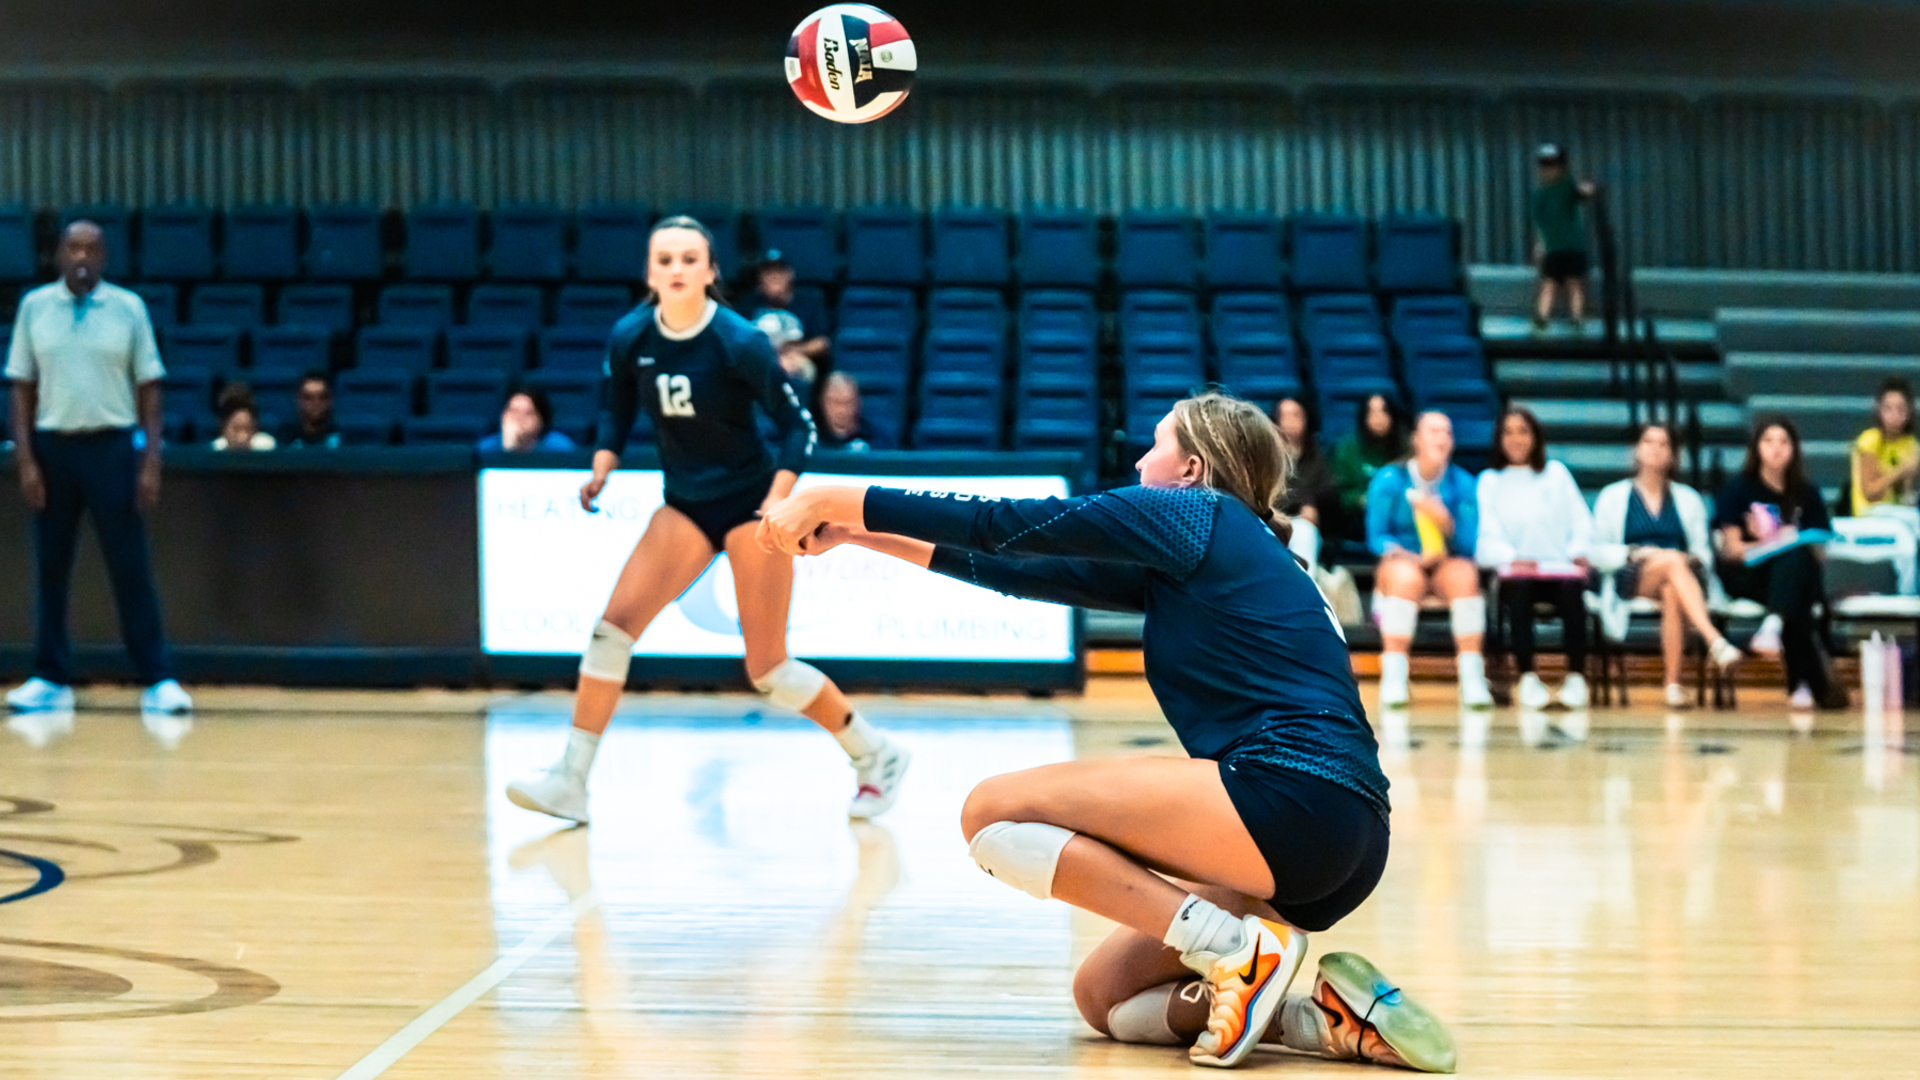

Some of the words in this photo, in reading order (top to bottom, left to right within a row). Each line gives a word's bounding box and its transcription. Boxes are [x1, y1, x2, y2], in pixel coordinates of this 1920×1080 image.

[823, 38, 843, 90] Baden
[849, 38, 873, 84] NAIA
[656, 373, 696, 416] 12
[496, 495, 641, 521] HEATNG
[498, 600, 594, 634] COOL
[876, 613, 1049, 642] PLUMBING
